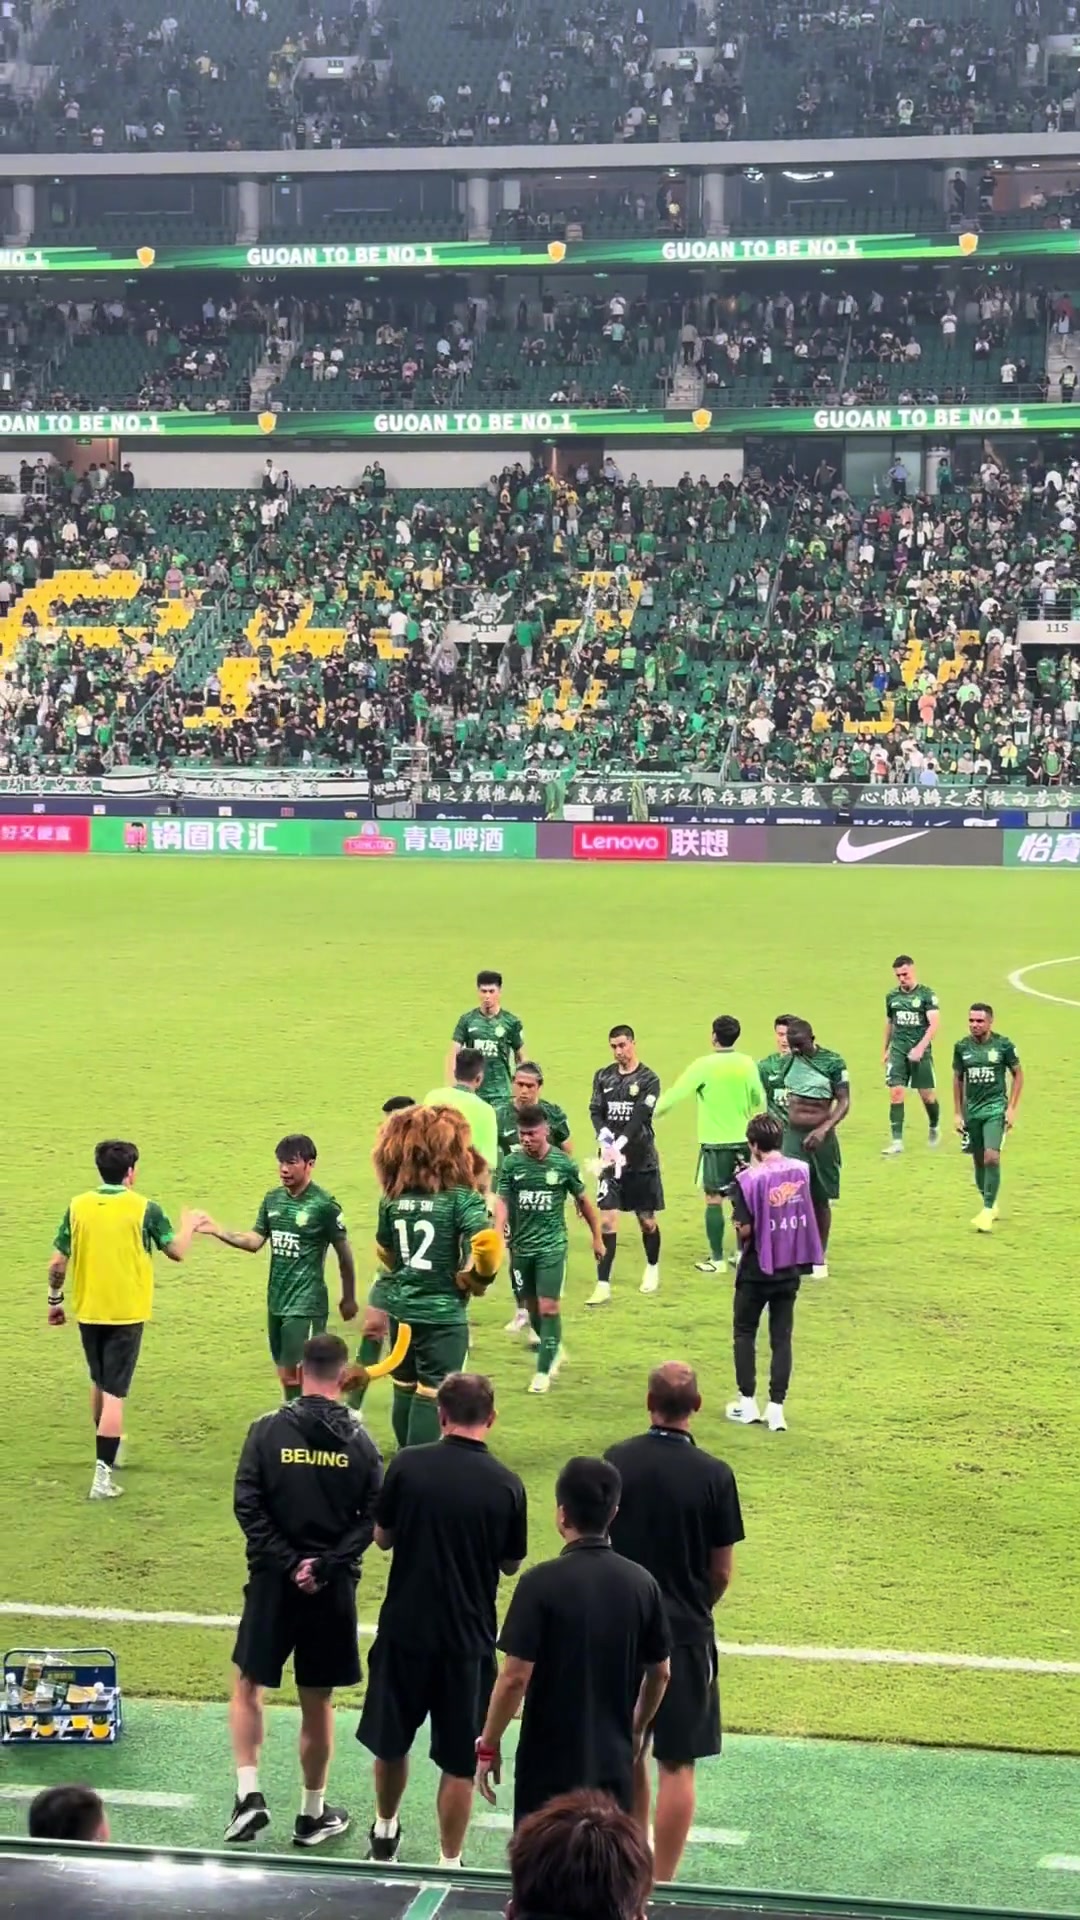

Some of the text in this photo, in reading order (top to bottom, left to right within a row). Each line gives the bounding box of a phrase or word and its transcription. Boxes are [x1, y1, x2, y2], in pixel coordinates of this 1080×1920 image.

[246, 246, 434, 265] GUOAN TO BE NO.1
[662, 239, 858, 260] GUOAN TO BE NO.1
[45, 415, 70, 432] TO
[79, 415, 105, 432] BE
[111, 415, 160, 432] NO.1
[374, 413, 572, 432] GUOAN TO BE NO.1
[813, 407, 1023, 429] GUOAN TO BE NO.1
[1046, 623, 1069, 633] 115
[151, 821, 279, 851] 锅圈食汇
[581, 828, 729, 857] Lenovo 联想
[518, 1189, 553, 1205] 京东
[271, 1230, 300, 1250] 京东
[394, 1218, 435, 1270] 12
[281, 1448, 349, 1468] BEIJING
